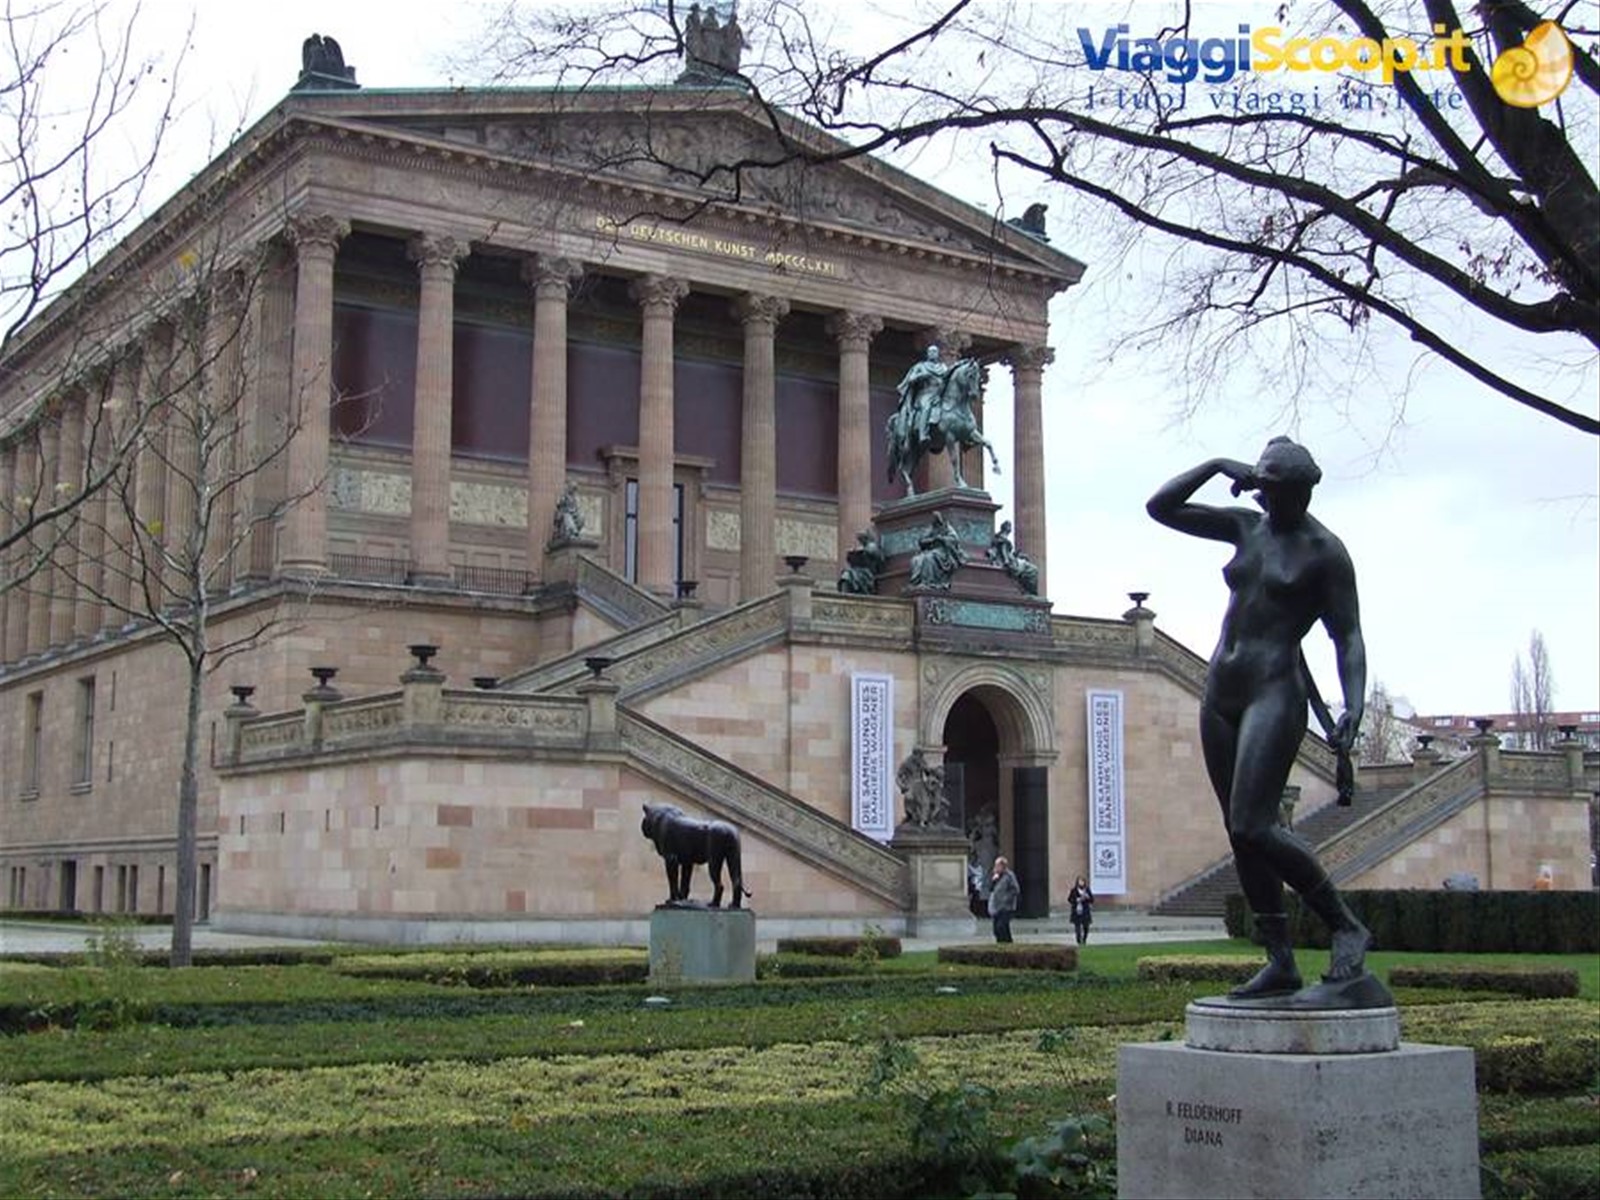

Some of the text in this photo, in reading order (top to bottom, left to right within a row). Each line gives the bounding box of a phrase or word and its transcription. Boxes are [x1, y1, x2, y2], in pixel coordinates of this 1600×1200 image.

[631, 224, 708, 249] DEUTSCHEN
[715, 240, 757, 258] KUNST
[862, 685, 871, 825] DIE SAMMLUNG DES
[870, 757, 878, 825] BANKIERS
[1177, 1102, 1242, 1125] FELDERHOFF
[1184, 1126, 1224, 1147] DIANA
